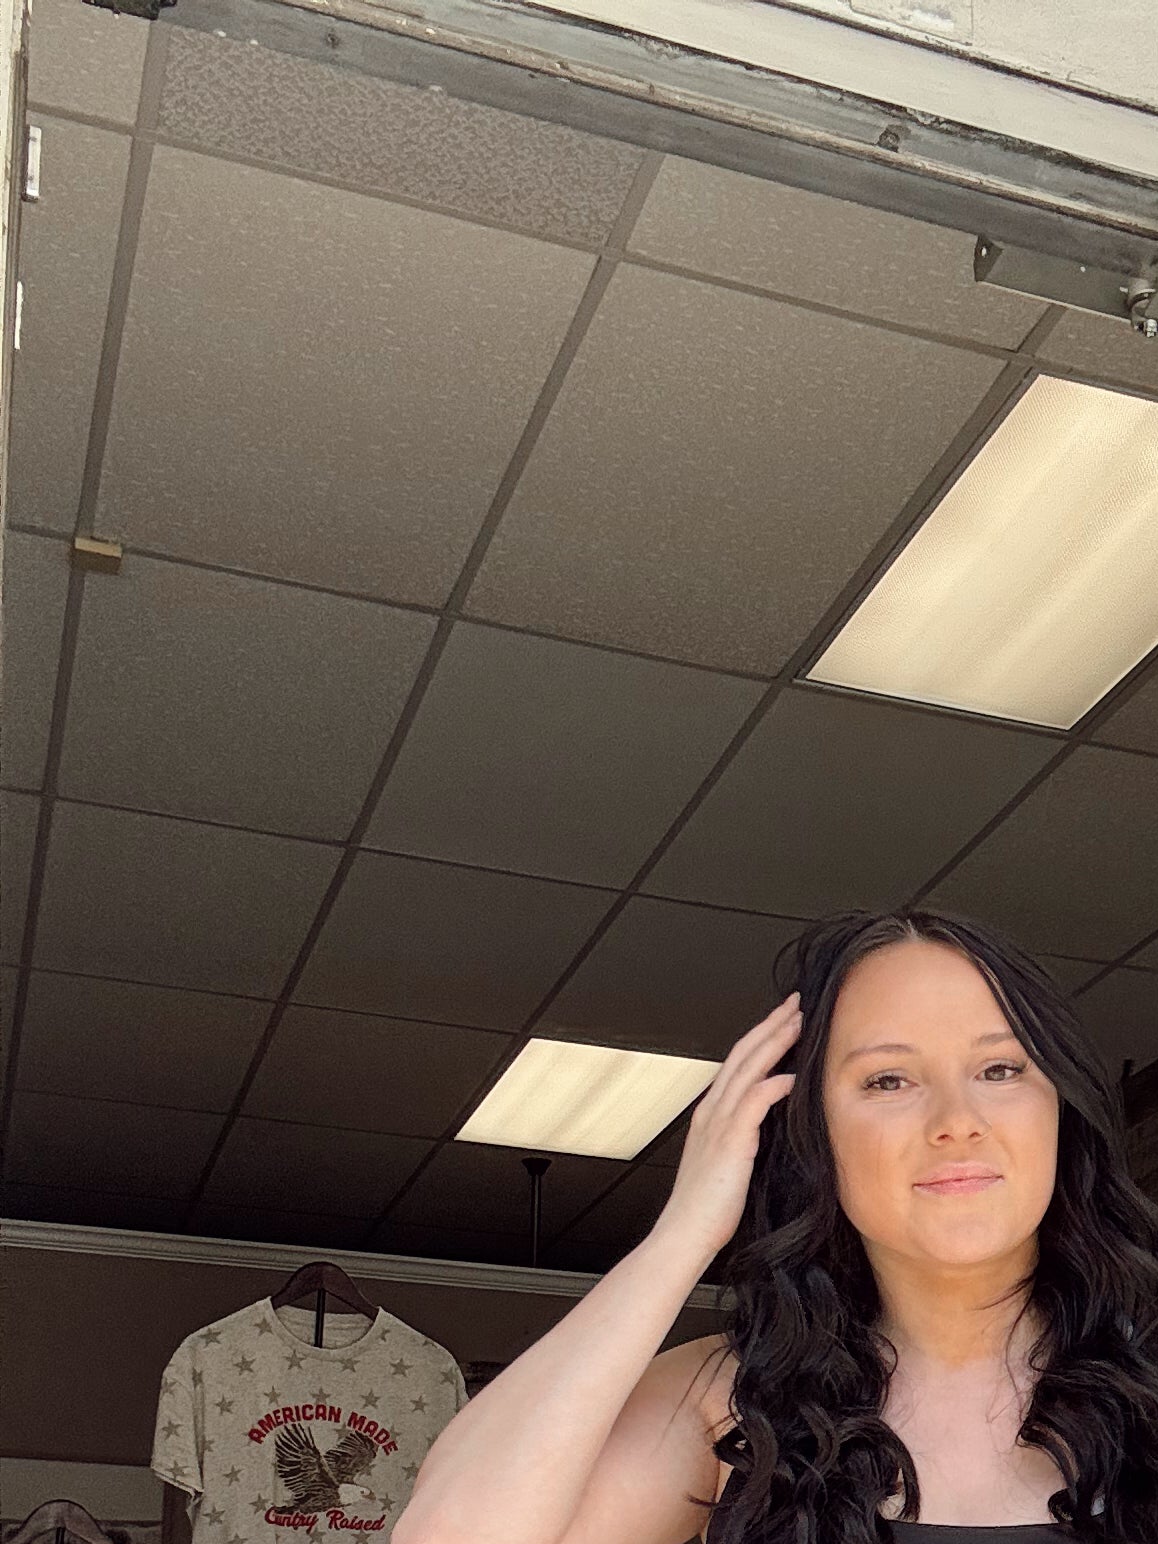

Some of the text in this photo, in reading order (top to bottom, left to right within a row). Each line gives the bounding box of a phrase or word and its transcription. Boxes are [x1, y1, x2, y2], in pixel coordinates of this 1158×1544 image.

[248, 1404, 399, 1456] AMERICAN MADE
[264, 1506, 386, 1535] Cuntry Raised
